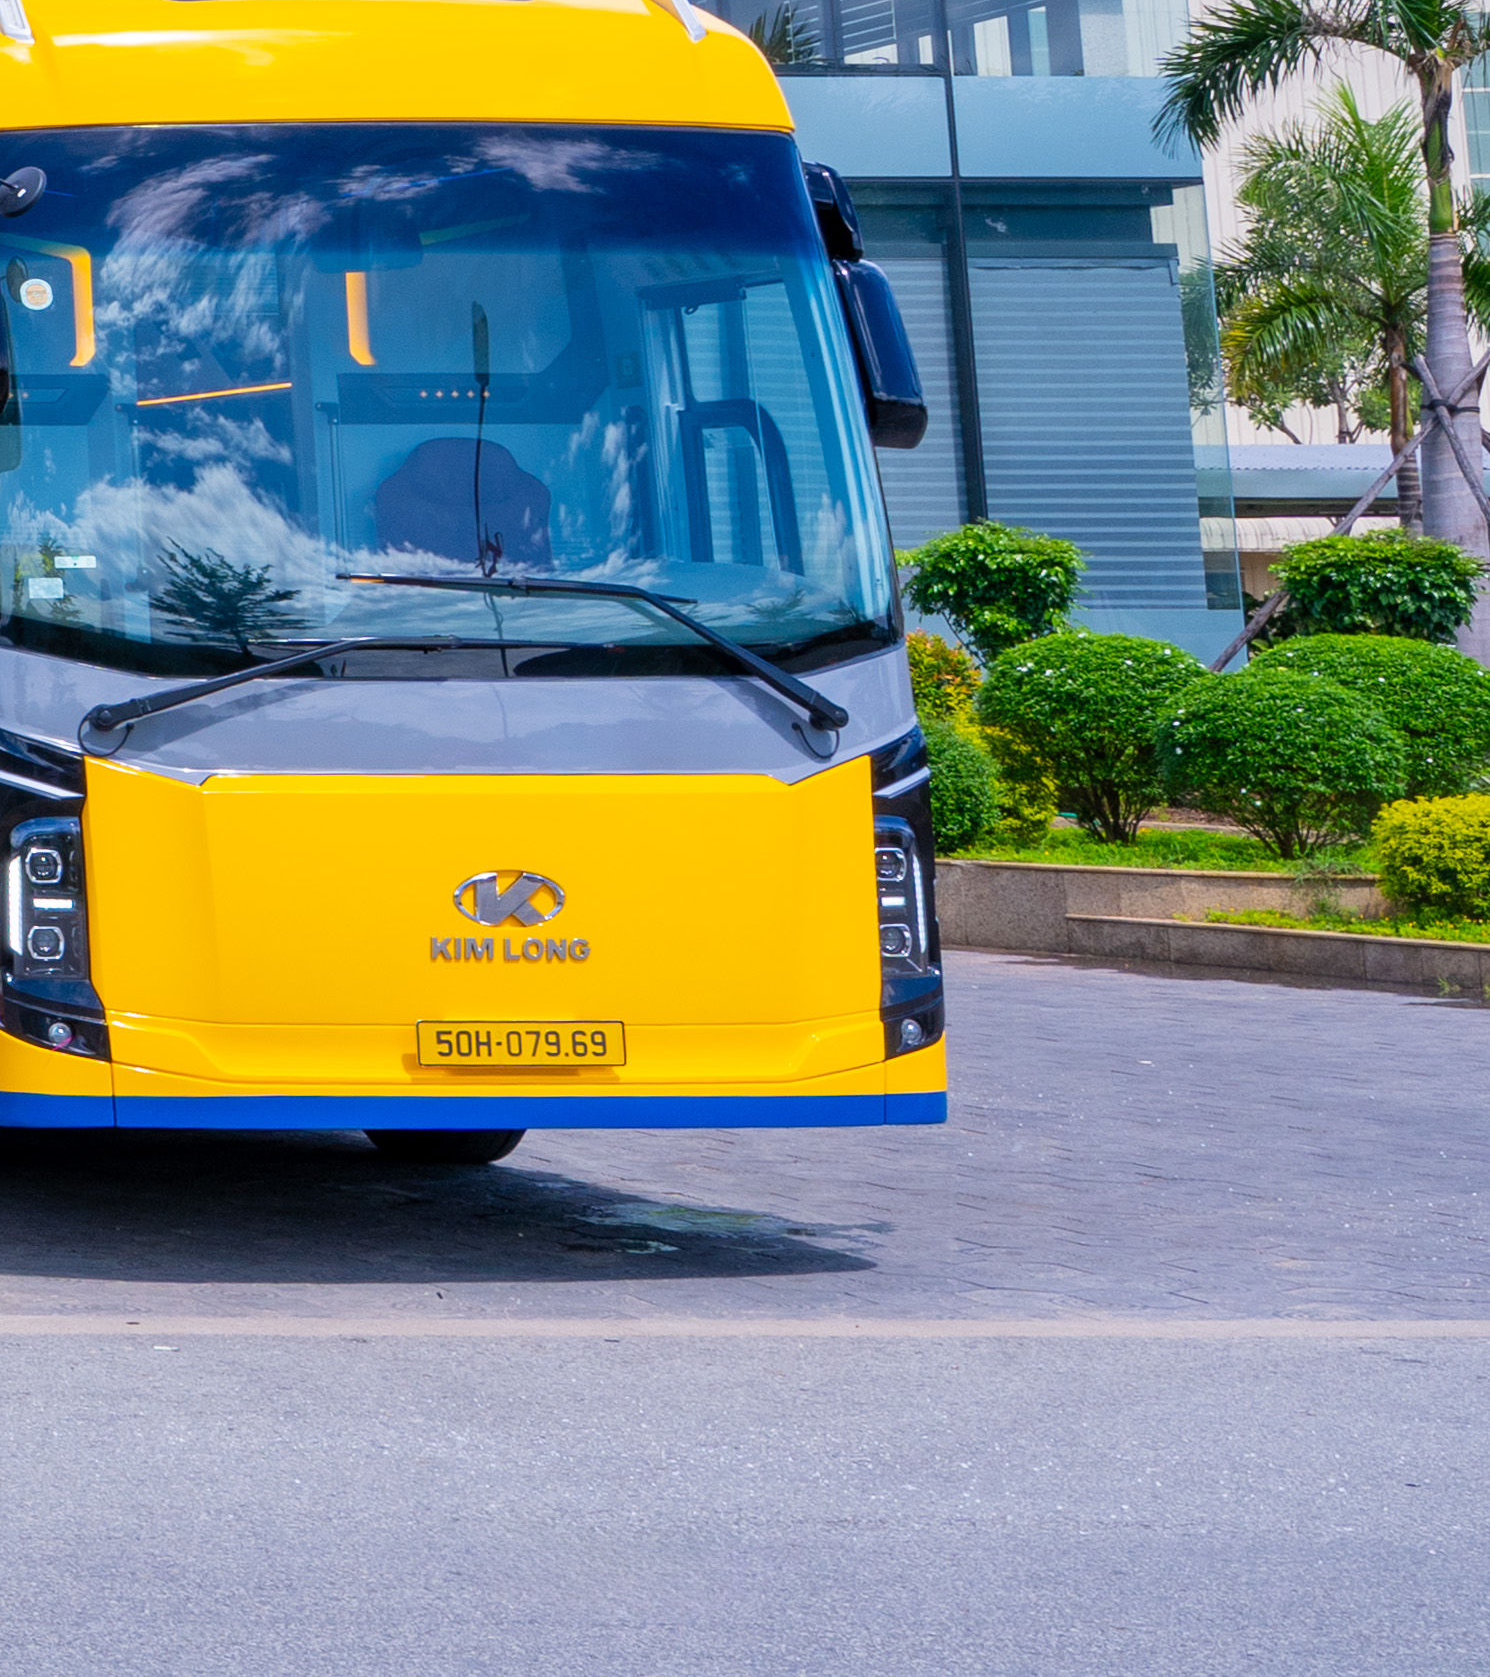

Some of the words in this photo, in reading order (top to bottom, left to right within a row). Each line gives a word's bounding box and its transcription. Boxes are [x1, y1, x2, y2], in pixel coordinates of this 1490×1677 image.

[431, 937, 495, 960] KIM
[504, 937, 591, 960] LONG
[436, 1030, 607, 1057] 50H-079.69
